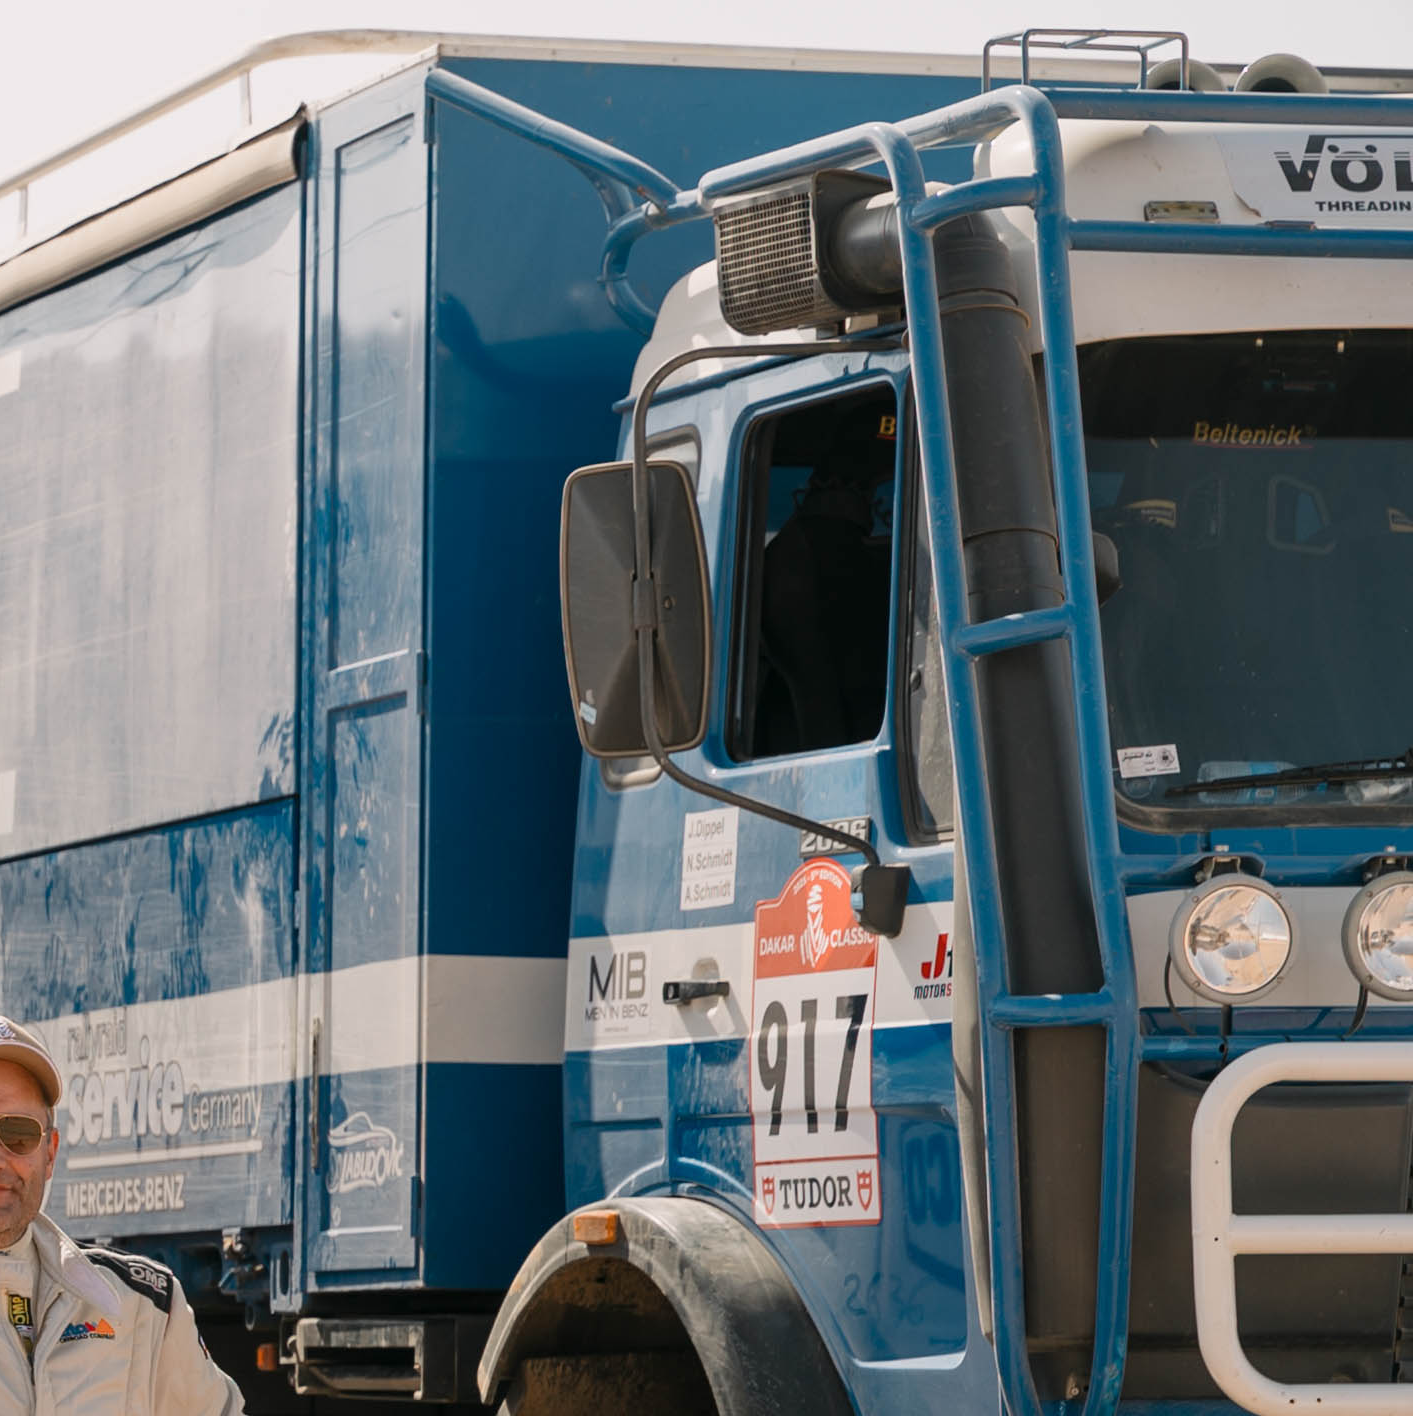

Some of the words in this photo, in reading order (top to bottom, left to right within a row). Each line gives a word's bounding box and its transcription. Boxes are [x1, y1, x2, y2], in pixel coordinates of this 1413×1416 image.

[1193, 421, 1302, 446] Beltenick
[760, 935, 795, 956] DAKAR
[589, 952, 646, 1002] MIB
[914, 983, 952, 1000] MOTORS
[622, 1003, 648, 1018] BENZ
[757, 994, 869, 1137] 917
[67, 1034, 185, 1146] service
[188, 1083, 262, 1137] Germany
[66, 1173, 186, 1218] MERCEDES-BENZ
[780, 1175, 852, 1210] TUDOR
[128, 1266, 168, 1289] OMP
